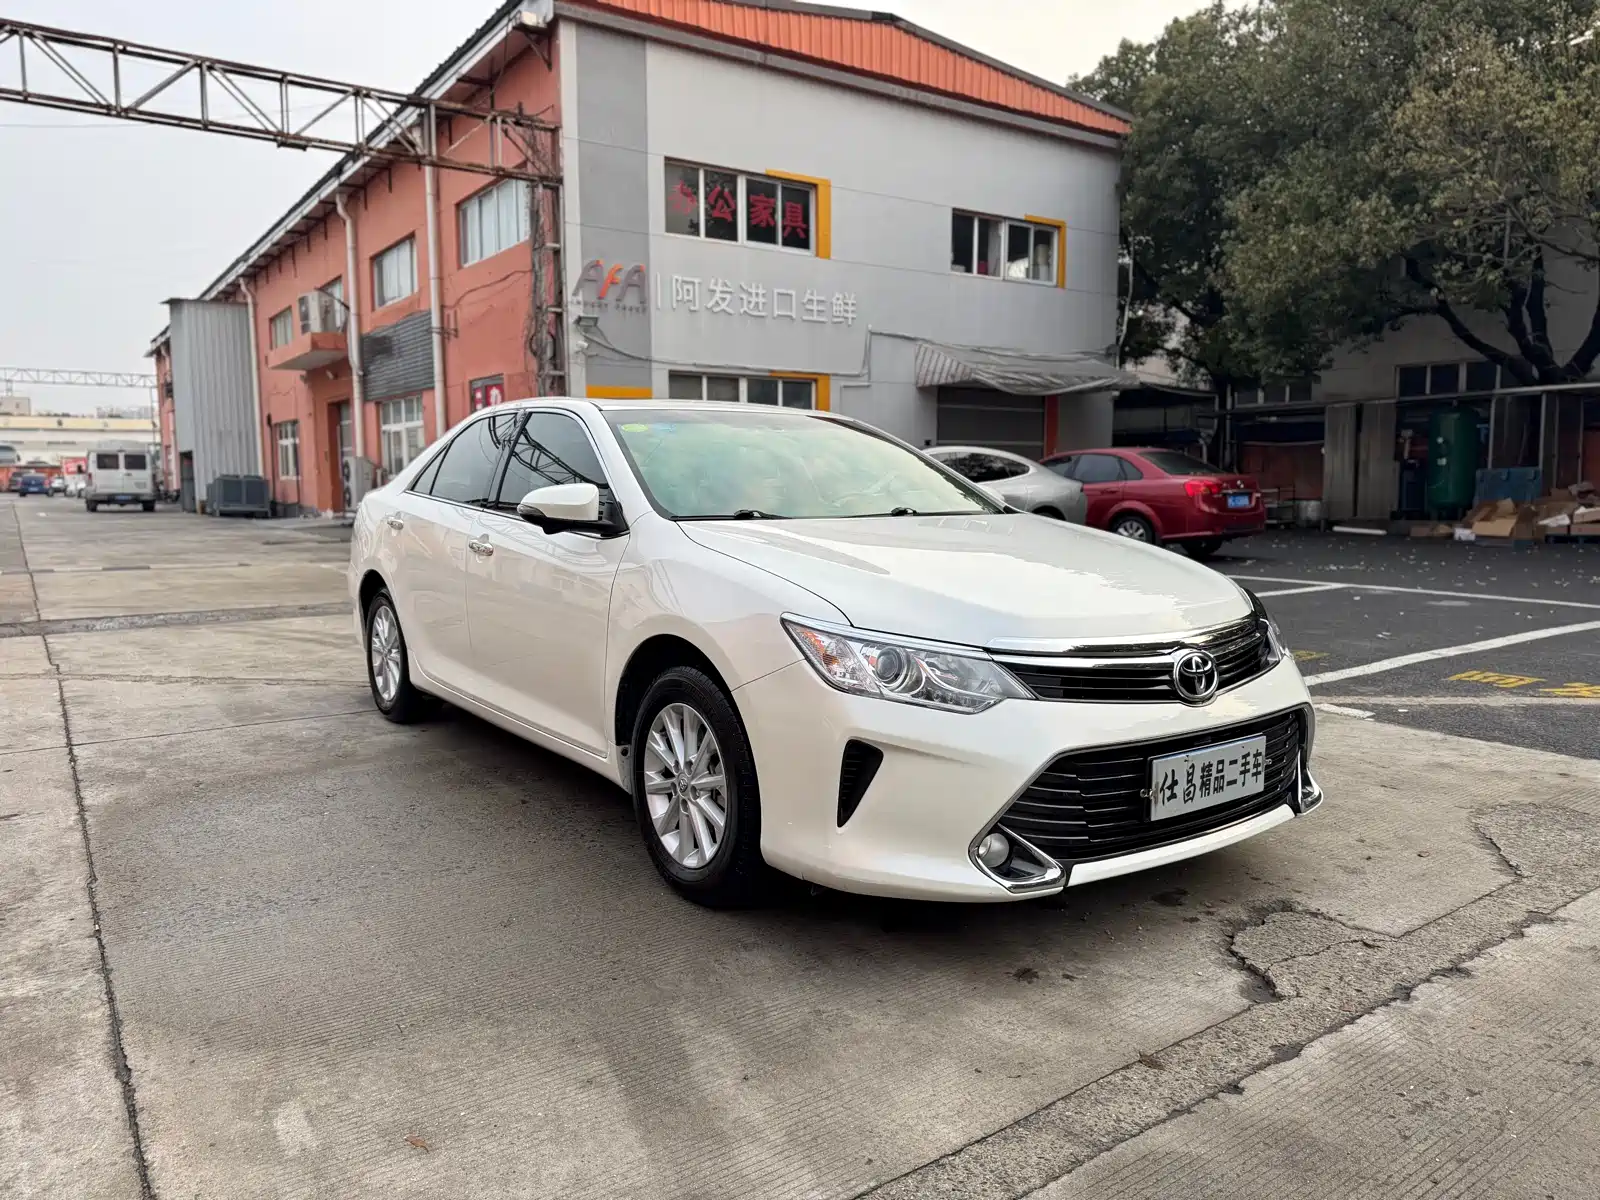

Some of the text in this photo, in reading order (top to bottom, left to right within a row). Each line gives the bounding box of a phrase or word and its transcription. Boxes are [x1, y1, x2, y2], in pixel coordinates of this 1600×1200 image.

[667, 179, 807, 239] 办公家具
[671, 274, 857, 326] 阿发进口生鲜
